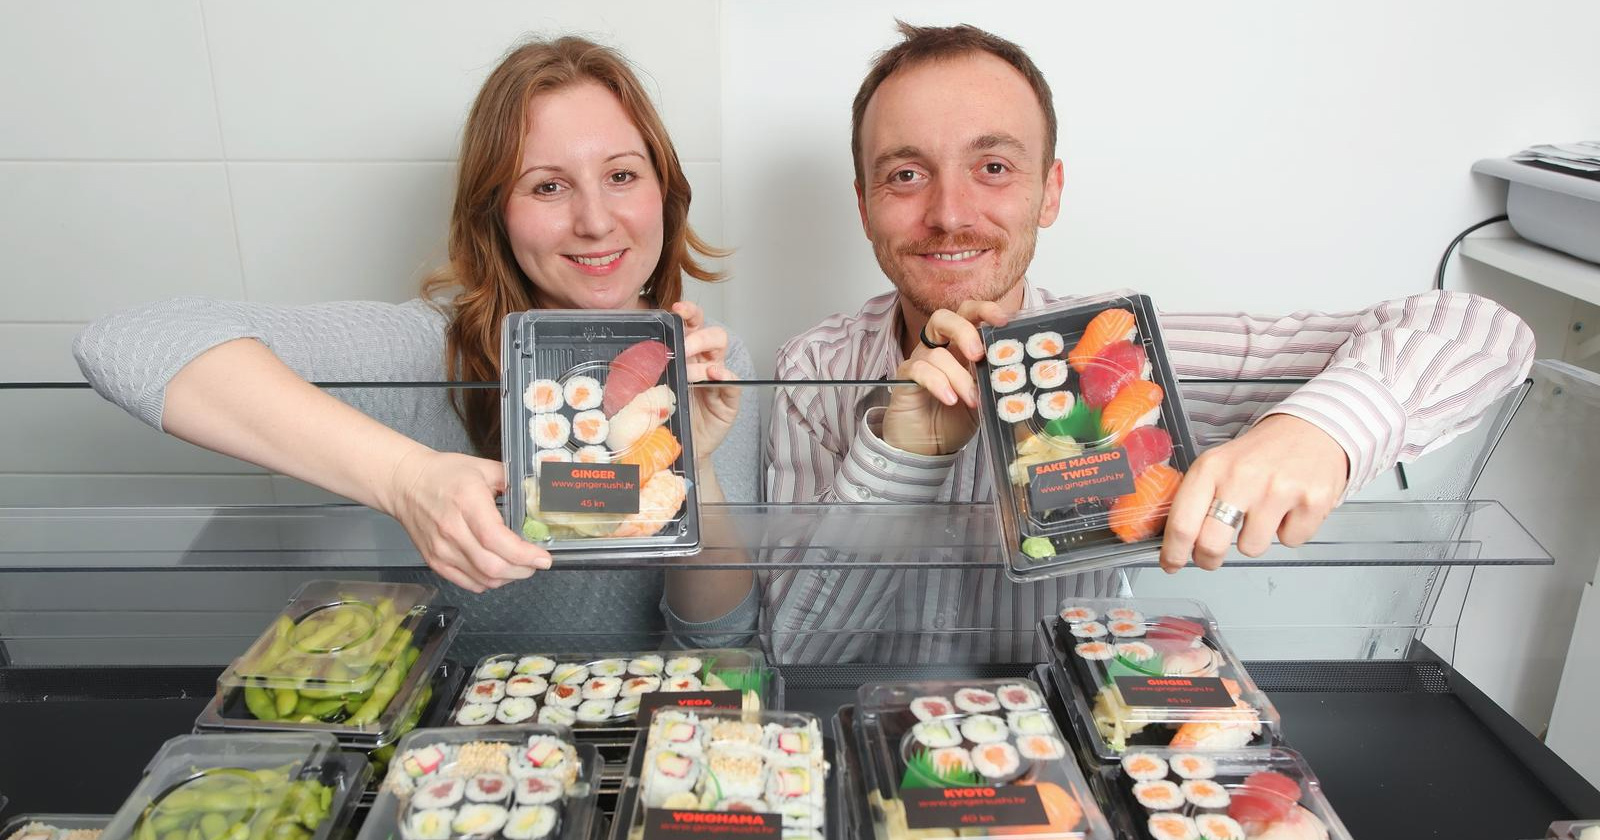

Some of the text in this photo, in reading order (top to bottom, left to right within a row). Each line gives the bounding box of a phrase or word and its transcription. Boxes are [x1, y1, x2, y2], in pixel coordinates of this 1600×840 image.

[1035, 451, 1121, 475] SAKE MAGURO
[571, 469, 616, 479] GINGER
[1061, 466, 1099, 480] TWIST
[1040, 472, 1125, 493] www.gingersushi.hr
[580, 499, 605, 508] 45 kn
[1147, 678, 1193, 686] GINGER
[944, 788, 996, 798] KYOTO
[672, 812, 765, 825] YOKOHAMA
